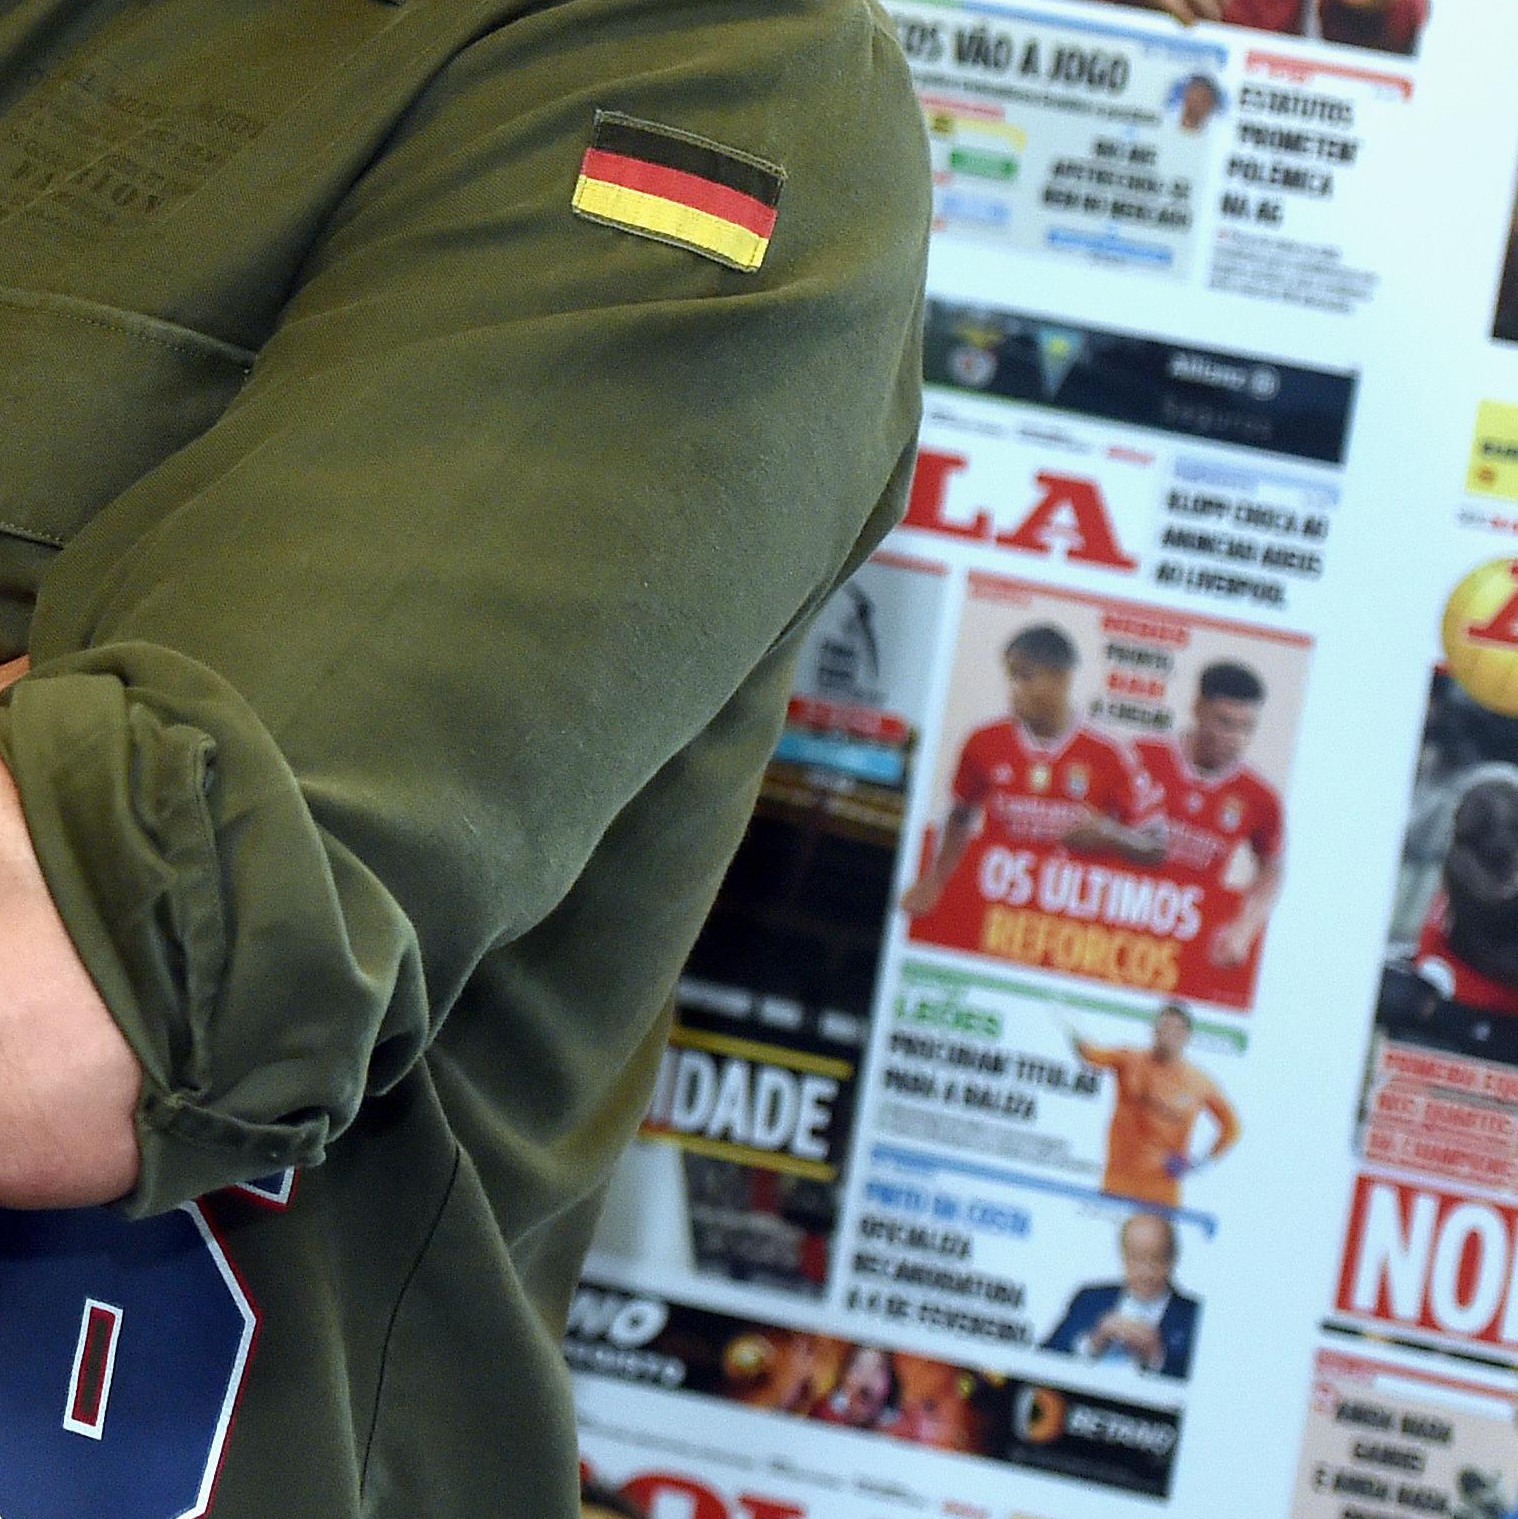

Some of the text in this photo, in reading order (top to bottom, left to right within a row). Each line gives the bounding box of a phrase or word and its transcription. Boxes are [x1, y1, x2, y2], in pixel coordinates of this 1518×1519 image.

[955, 24, 1131, 96] VÃO A JOGO
[897, 448, 1139, 572] LA
[979, 846, 1204, 942] OS ÚLTIMOS
[984, 902, 1180, 993] REFORÇOS
